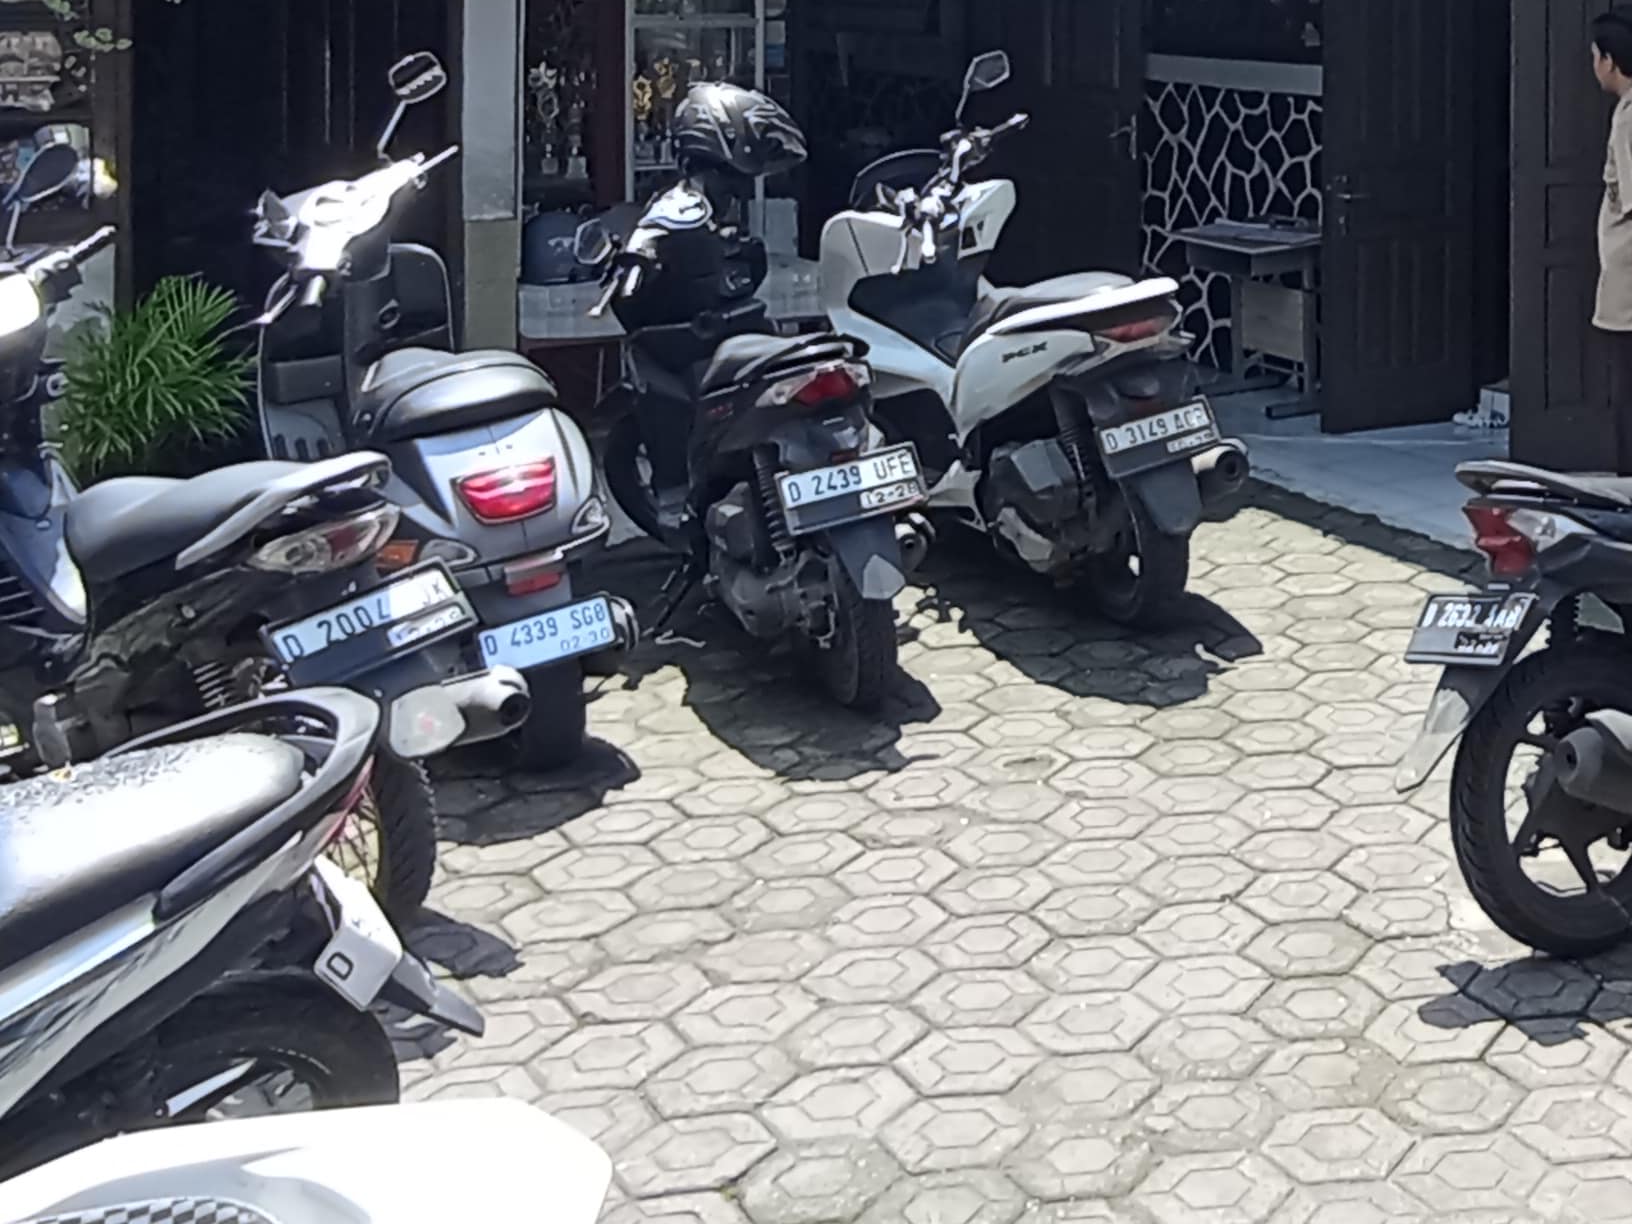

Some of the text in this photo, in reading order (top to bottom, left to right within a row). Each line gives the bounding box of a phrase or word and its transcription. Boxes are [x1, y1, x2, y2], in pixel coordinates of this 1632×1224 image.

[1105, 432, 1118, 451] D
[1125, 418, 1169, 445] 3149
[787, 481, 801, 503] D
[811, 465, 863, 496] 2439
[483, 603, 606, 656] D 4339 SGB
[282, 633, 305, 660] D
[326, 952, 354, 981] D
